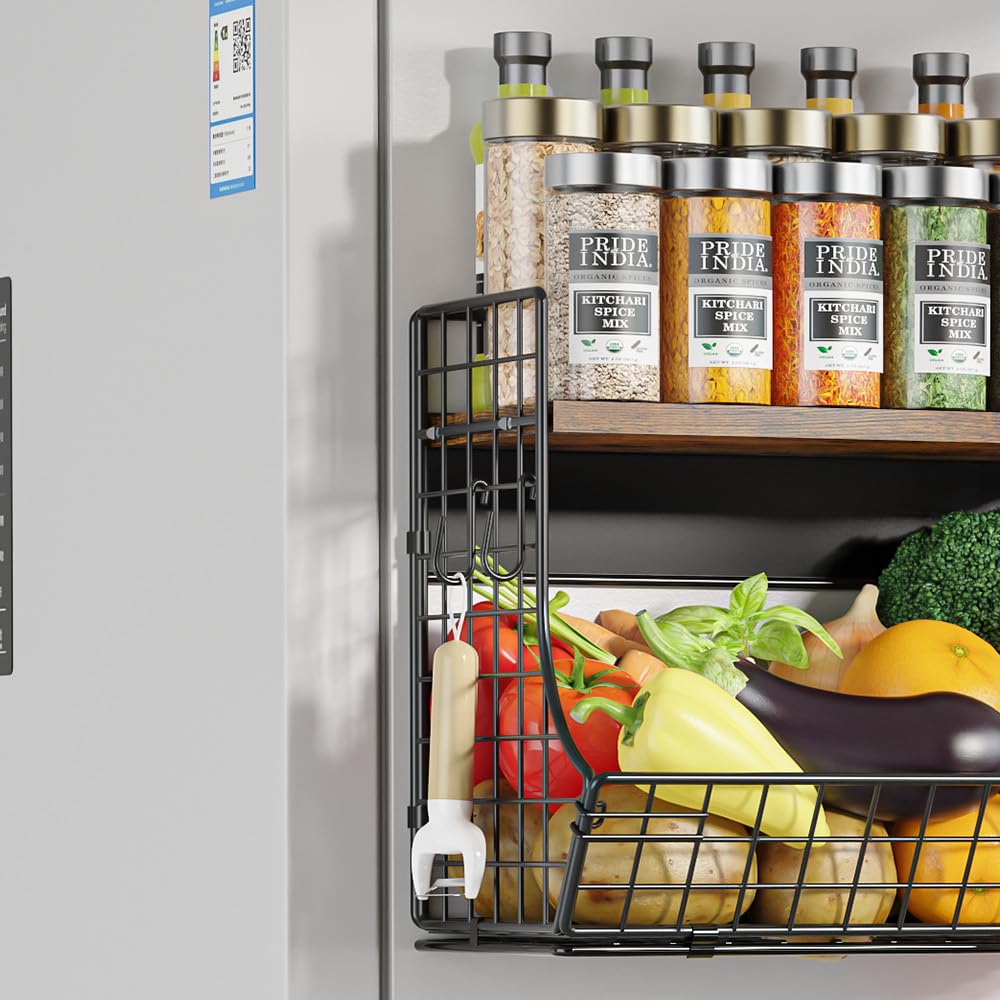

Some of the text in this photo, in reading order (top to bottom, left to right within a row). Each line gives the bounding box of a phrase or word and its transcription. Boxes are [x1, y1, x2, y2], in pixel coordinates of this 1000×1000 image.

[580, 237, 649, 252] PRIDE
[700, 241, 765, 258] PRIDE
[816, 245, 877, 262] PRIDE
[927, 248, 986, 266] PRIDE
[581, 295, 646, 306] KITCHARI
[702, 299, 763, 310] KITCHARI
[594, 307, 636, 317] SPICE
[817, 303, 876, 314] KITCHARI
[928, 306, 984, 317] KITCHARI
[715, 311, 754, 321] SPICE
[830, 315, 868, 324] SPICE
[602, 319, 629, 329] MIX
[722, 323, 748, 332] MIX
[941, 318, 977, 328] SPICE
[838, 326, 862, 336] MIX
[948, 329, 972, 339] MIX
